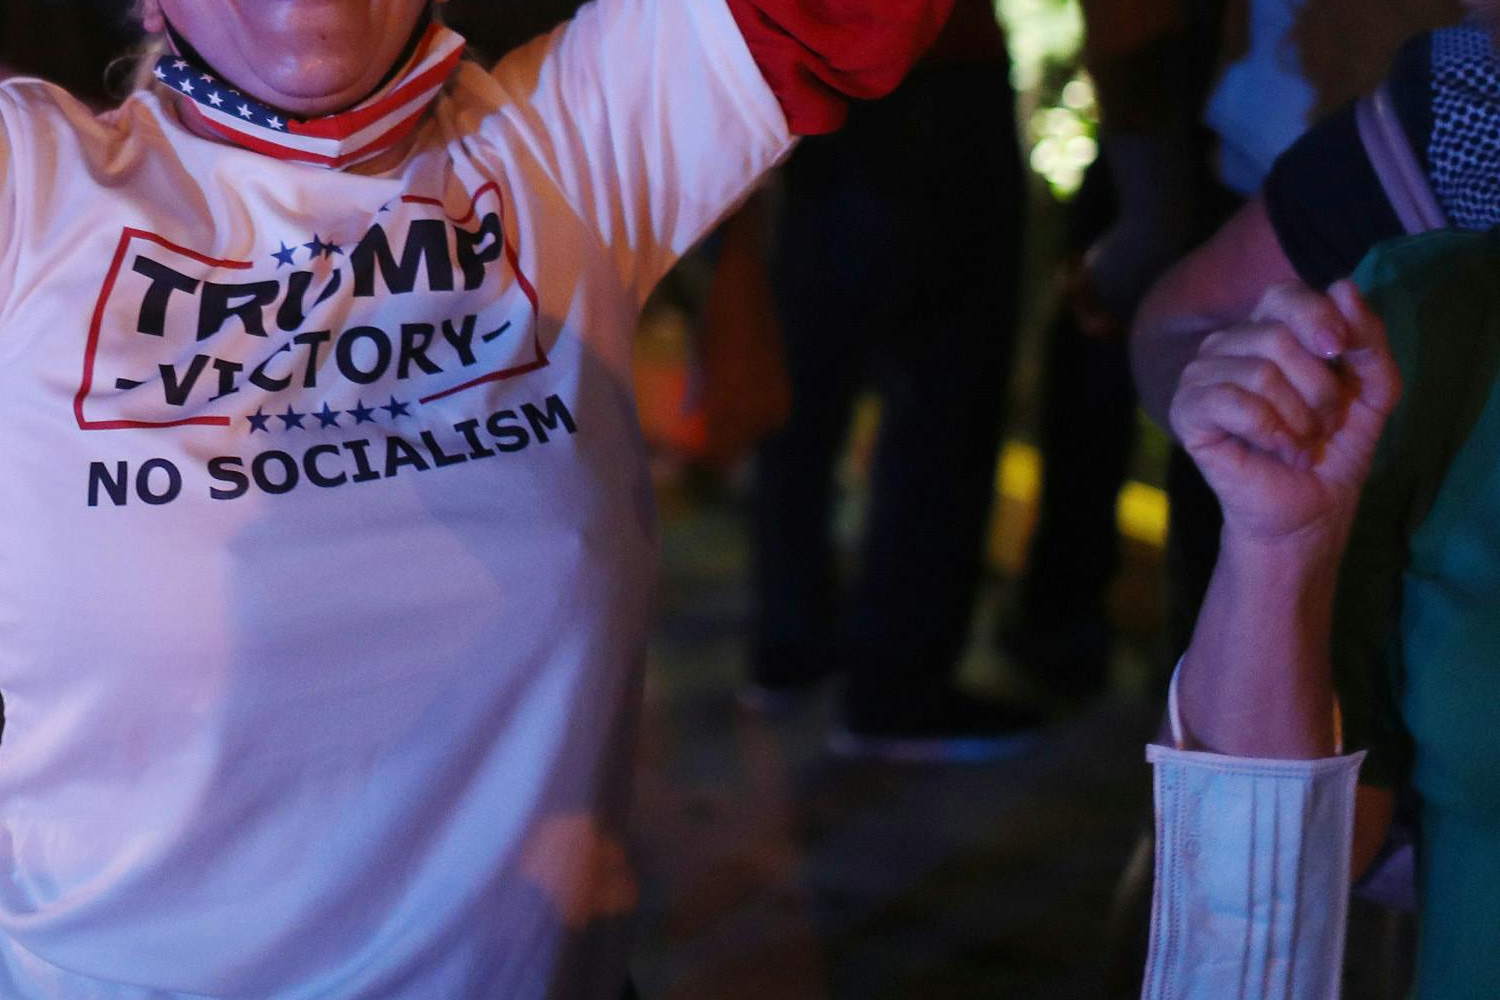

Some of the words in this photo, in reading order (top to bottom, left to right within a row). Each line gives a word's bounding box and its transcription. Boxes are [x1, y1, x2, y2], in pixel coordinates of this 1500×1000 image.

[131, 212, 501, 341] TRUMP
[88, 459, 182, 507] NO
[208, 394, 577, 501] SOCIALISM
